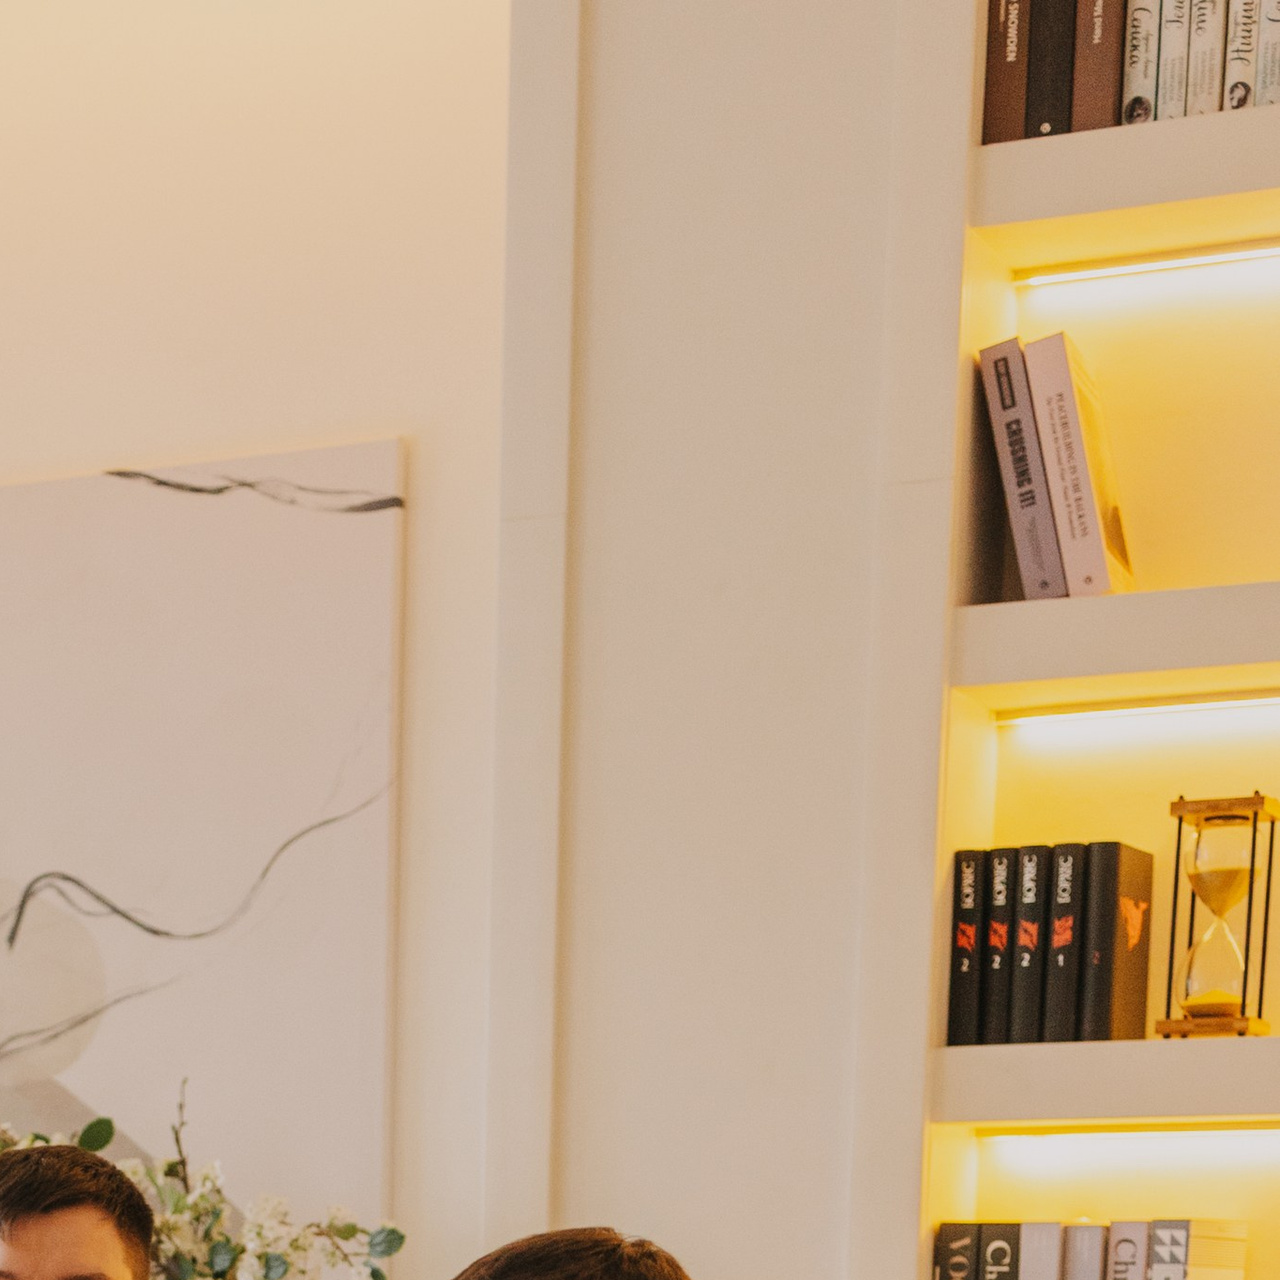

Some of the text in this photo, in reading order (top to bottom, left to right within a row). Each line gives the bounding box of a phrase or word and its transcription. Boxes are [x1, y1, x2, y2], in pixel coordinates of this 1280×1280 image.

[1006, 2, 1019, 62] SNOWDEN
[961, 957, 970, 972] 2
[992, 954, 1001, 969] 2
[1021, 952, 1031, 967] 2
